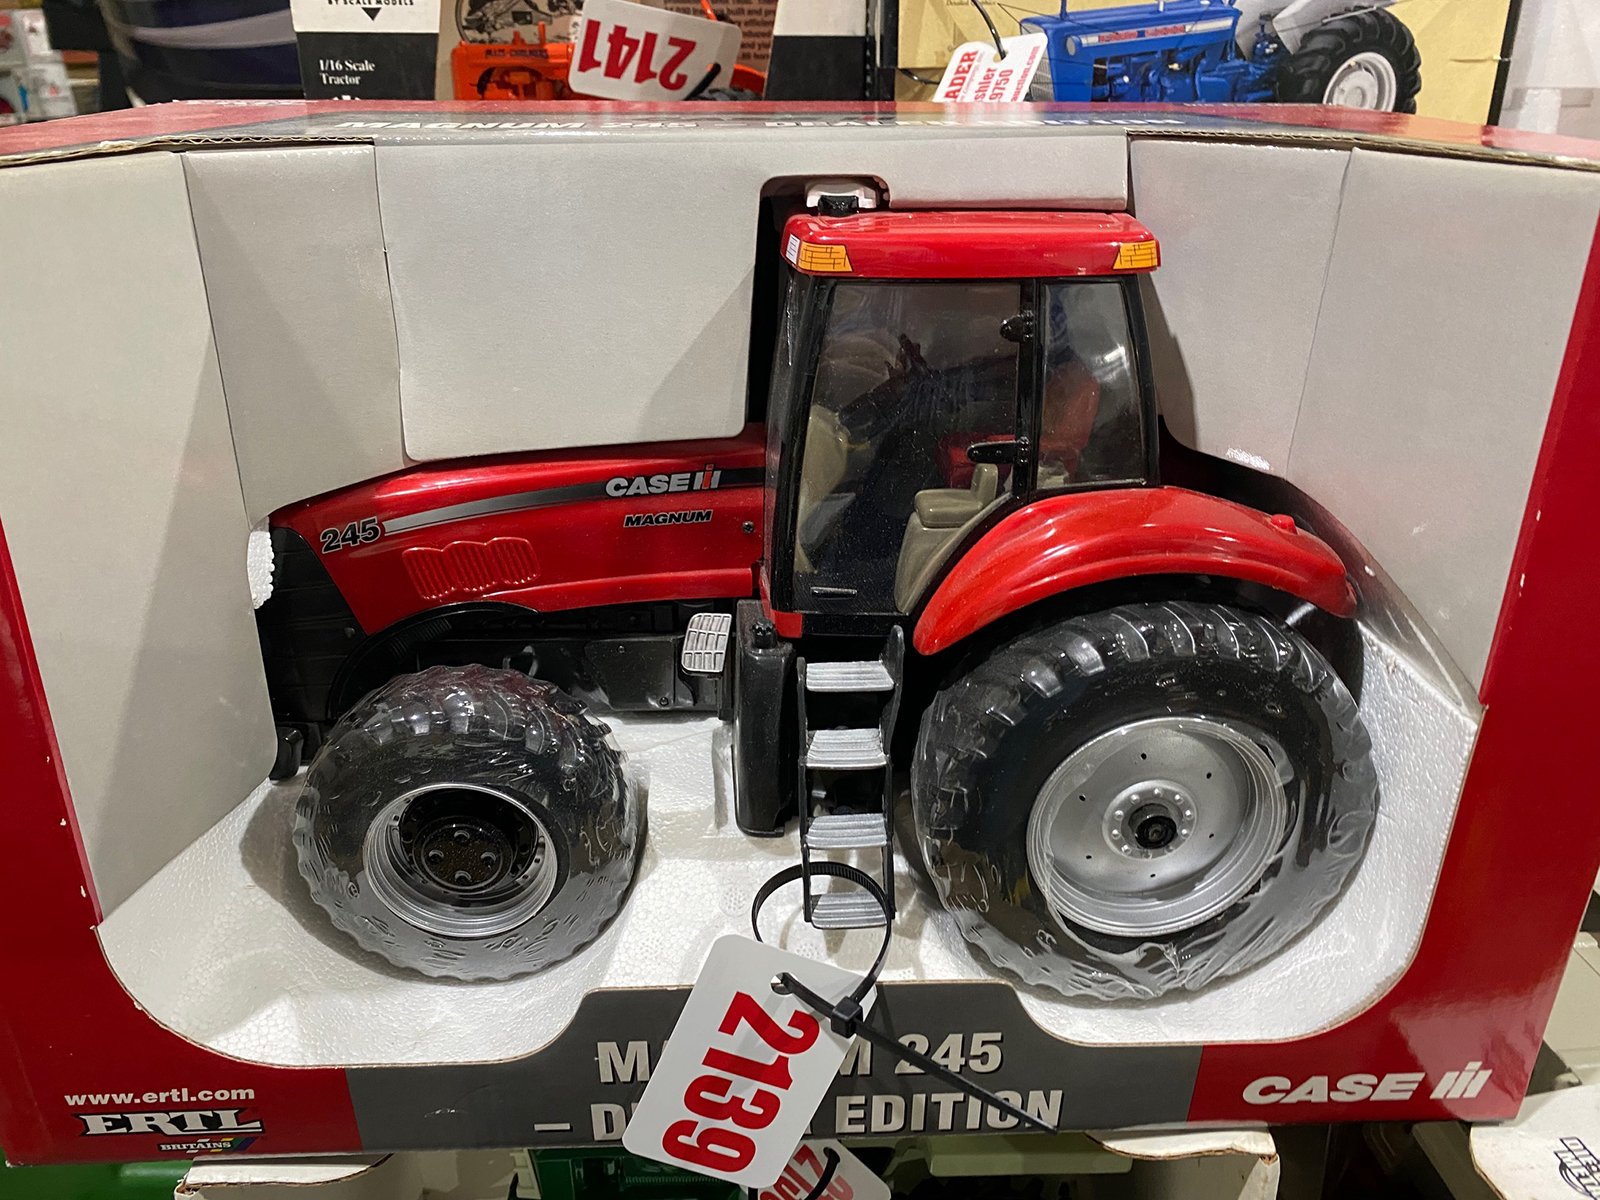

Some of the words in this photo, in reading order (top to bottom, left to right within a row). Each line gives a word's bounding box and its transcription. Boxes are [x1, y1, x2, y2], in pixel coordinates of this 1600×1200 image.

[319, 59, 343, 71] 1/16
[344, 59, 376, 71] Scale
[578, 19, 697, 91] 2141
[319, 72, 361, 85] Tractor
[605, 473, 689, 498] CASE
[623, 509, 713, 528] MAGNUM
[319, 515, 382, 554] 245
[894, 1032, 1002, 1074] 245
[661, 990, 821, 1174] 2139
[1242, 1071, 1426, 1105] CASE
[64, 1087, 255, 1106] www.ertl.com
[79, 1109, 263, 1136] ERTL
[835, 1090, 1063, 1134] EDITION
[160, 1140, 232, 1151] BRITAINS
